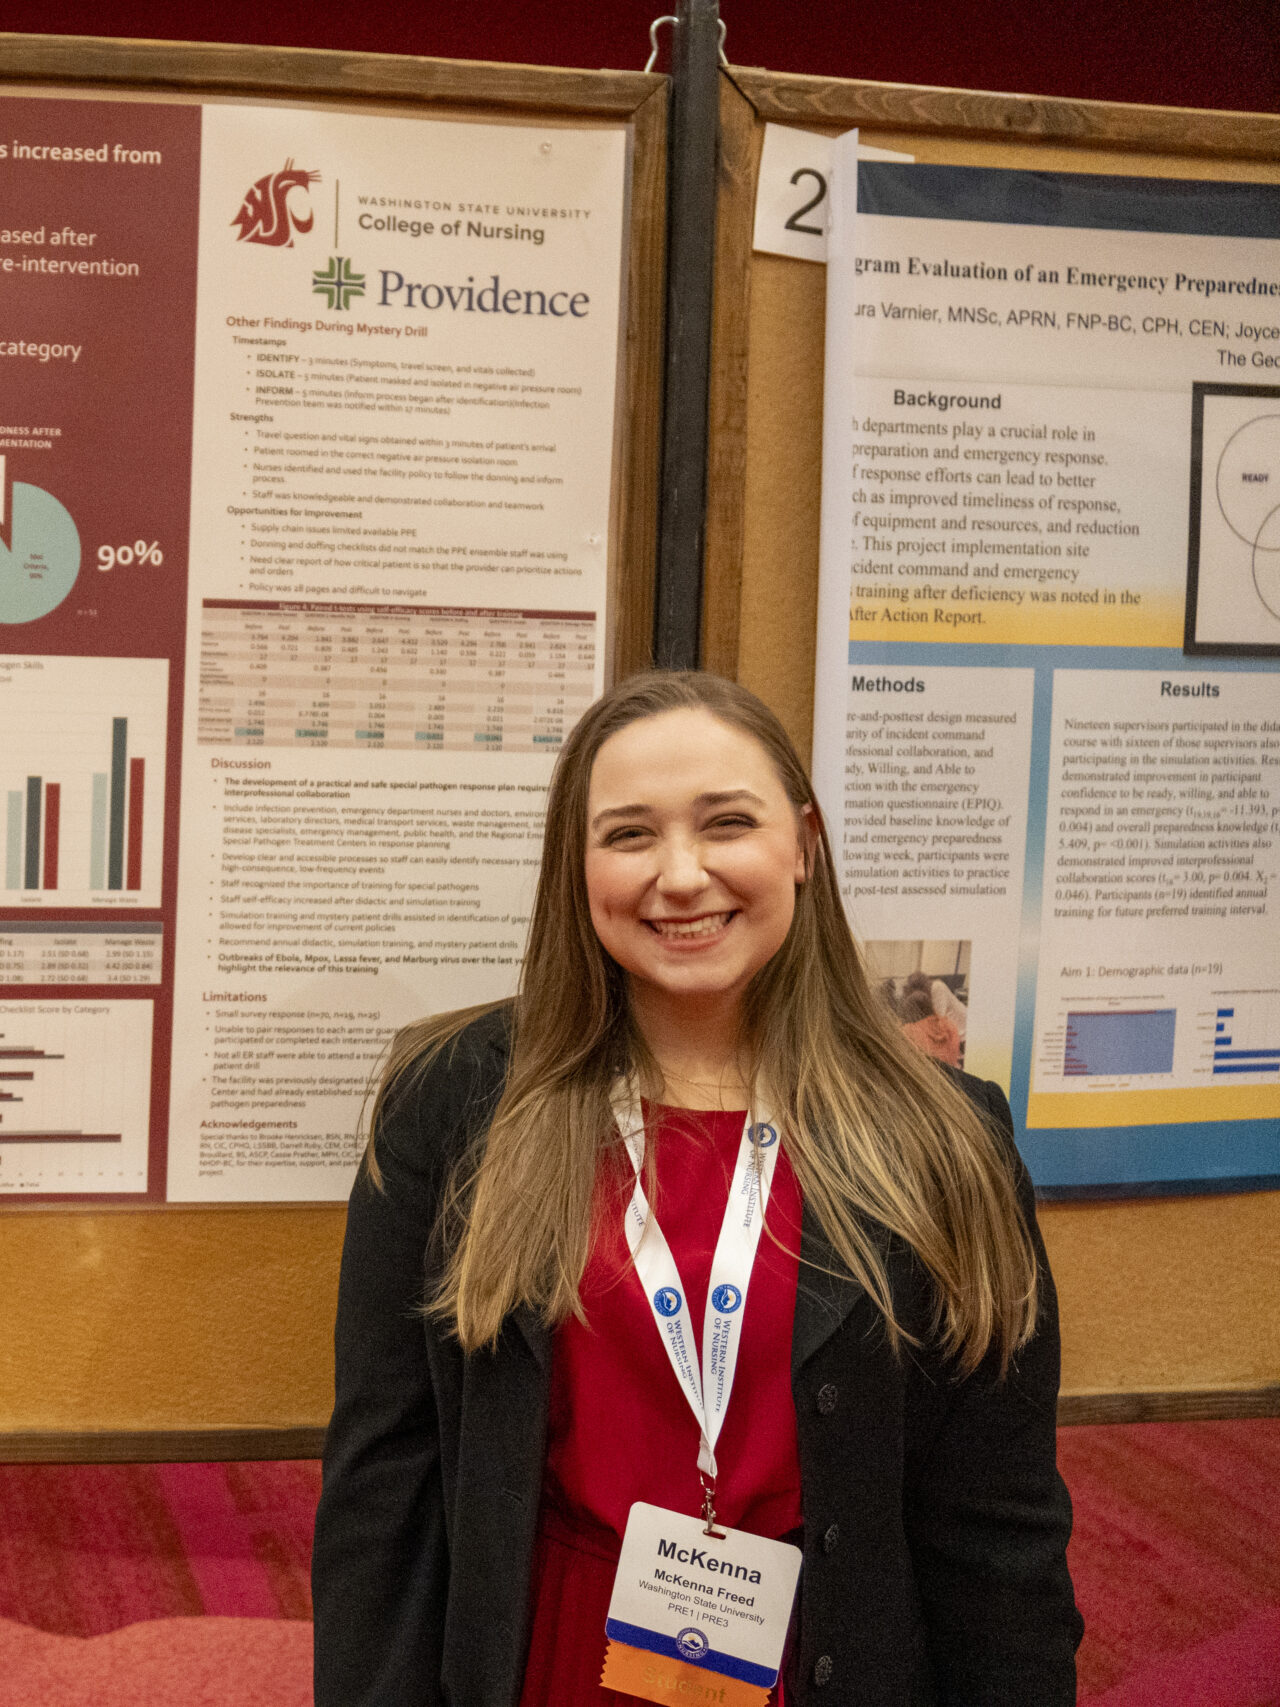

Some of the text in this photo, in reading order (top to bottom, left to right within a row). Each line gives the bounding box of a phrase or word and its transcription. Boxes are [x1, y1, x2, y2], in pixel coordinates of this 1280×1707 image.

[13, 139, 107, 162] increased
[112, 143, 161, 164] from
[358, 196, 589, 218] WASHINGTON STATE UNIVERSITY
[783, 167, 828, 237] 2
[358, 213, 544, 245] College of Nursing
[855, 258, 899, 274] gram
[908, 257, 1007, 280] Evaluation
[1014, 264, 1033, 282] of
[1038, 270, 1058, 284] an
[1067, 267, 1164, 295] Emergency
[379, 270, 589, 318] Providence
[226, 315, 427, 338] Other Findings During Mystery Drill
[881, 302, 940, 322] Varnier,
[948, 305, 1000, 326] MNSc,
[1006, 309, 1059, 329] APRN,
[1066, 312, 1135, 333] FNP-BC,
[1142, 316, 1182, 336] CPH,
[1188, 319, 1228, 339] CEN;
[1235, 322, 1280, 342] Joyce
[1218, 349, 1246, 366] The
[894, 389, 1000, 411] Background
[32, 427, 61, 436] AFTER
[862, 417, 1095, 441] departments play a crucial role in
[98, 539, 162, 571] 90%
[852, 675, 924, 692] Methods
[1161, 681, 1219, 697] Results
[211, 757, 270, 769] Discussion
[1060, 966, 1082, 977] Aim
[1098, 965, 1164, 979] Demographic
[1167, 964, 1188, 975] data
[1191, 962, 1222, 976] (n=19)
[202, 991, 267, 1002] Limitations
[200, 1119, 297, 1131] Acknowledgements
[666, 1322, 675, 1335] OF
[674, 1319, 689, 1363] WESTERN
[711, 1317, 721, 1375] OF NURSING
[719, 1319, 732, 1364] WESTERN
[657, 1538, 762, 1585] McKenna
[654, 1568, 755, 1608] McKenna Freed
[638, 1579, 766, 1626] Washington State University
[667, 1602, 729, 1628] PRE1 PRE3
[643, 1665, 726, 1703] Student
